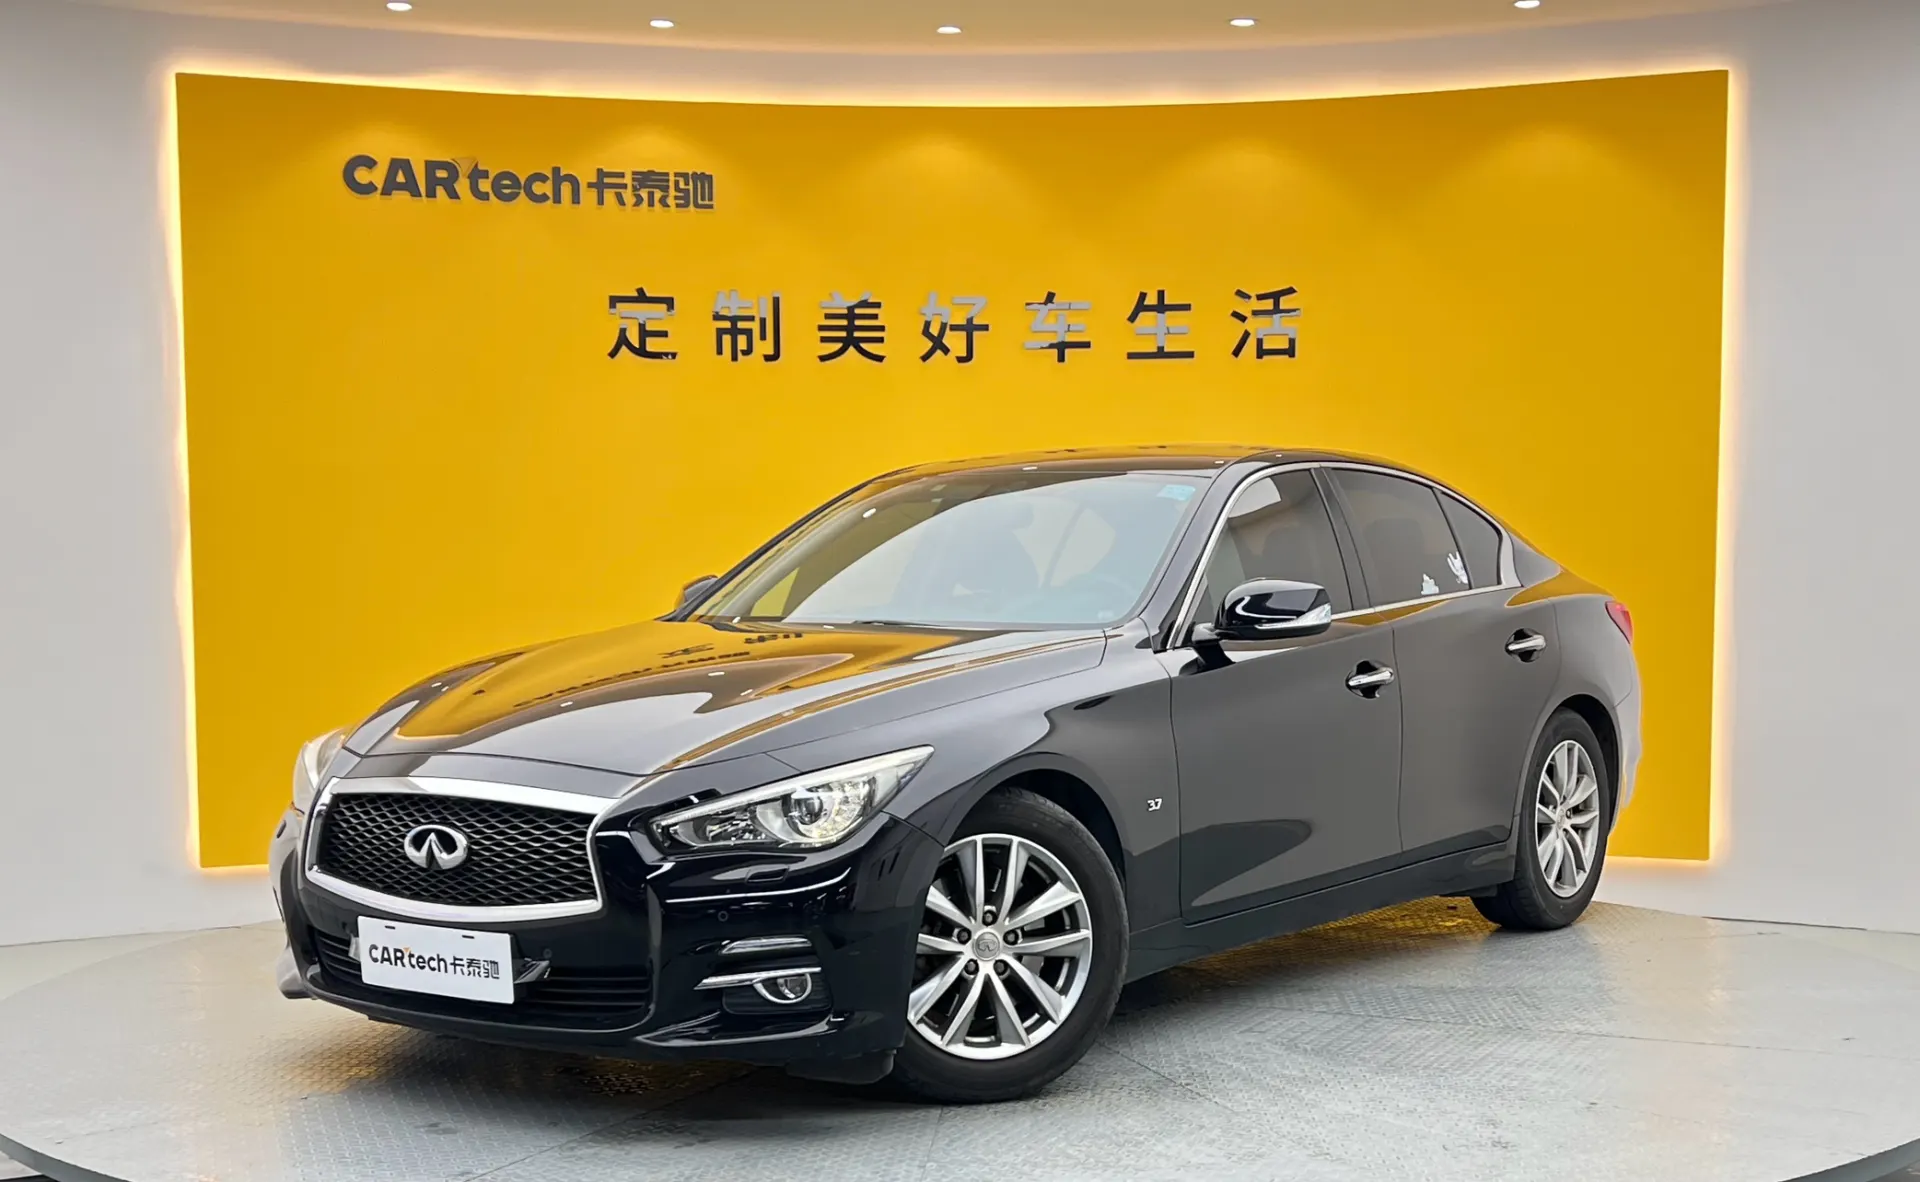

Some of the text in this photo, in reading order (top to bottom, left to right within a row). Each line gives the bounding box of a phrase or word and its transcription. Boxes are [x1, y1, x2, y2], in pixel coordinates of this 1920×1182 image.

[342, 154, 715, 211] CARtech 卡泰驰
[606, 285, 1302, 364] 定制美好车生活
[368, 943, 501, 980] CARtech 卡泰驰
